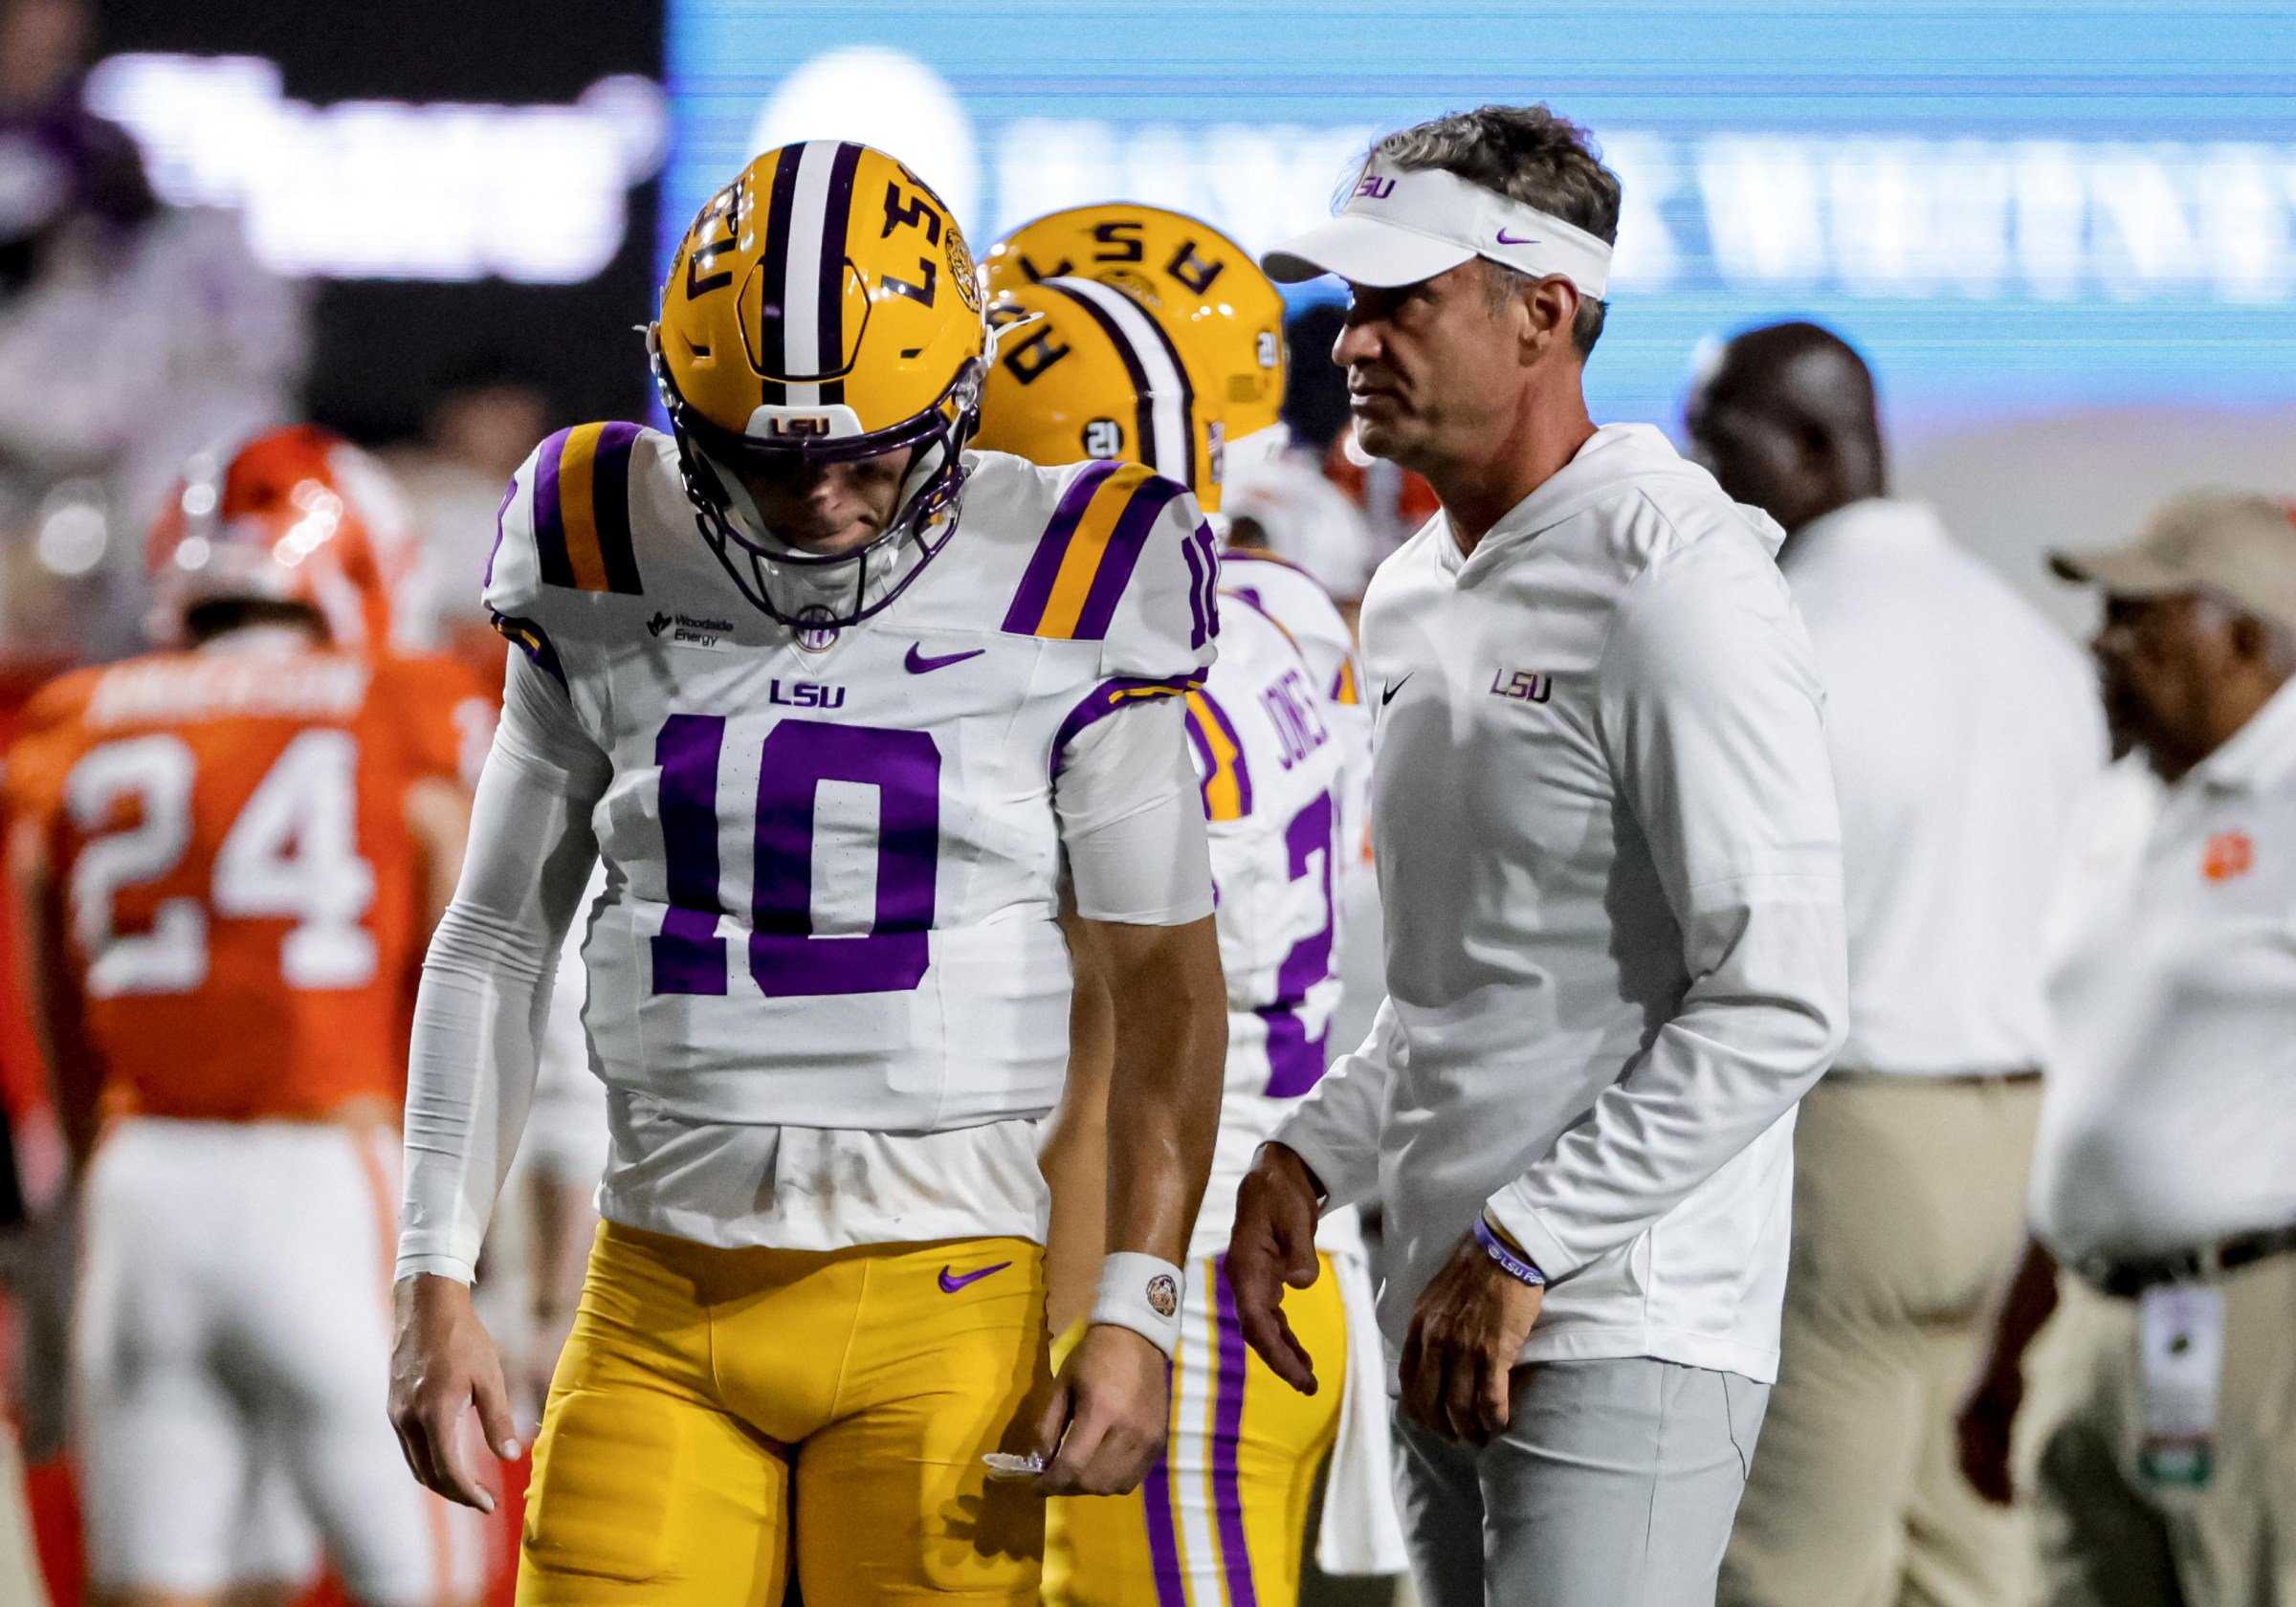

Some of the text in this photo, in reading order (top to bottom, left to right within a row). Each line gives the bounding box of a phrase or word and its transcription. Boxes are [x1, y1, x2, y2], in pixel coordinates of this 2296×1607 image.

[1016, 221, 1225, 296] LSU
[1087, 421, 1120, 458] 21
[674, 628, 718, 647] Energy
[675, 614, 734, 632] Woodside
[769, 678, 846, 709] LSU
[1490, 668, 1553, 703] LSU
[67, 725, 377, 999] 24
[651, 714, 942, 998] 10
[1500, 1256, 1524, 1277] LSU
